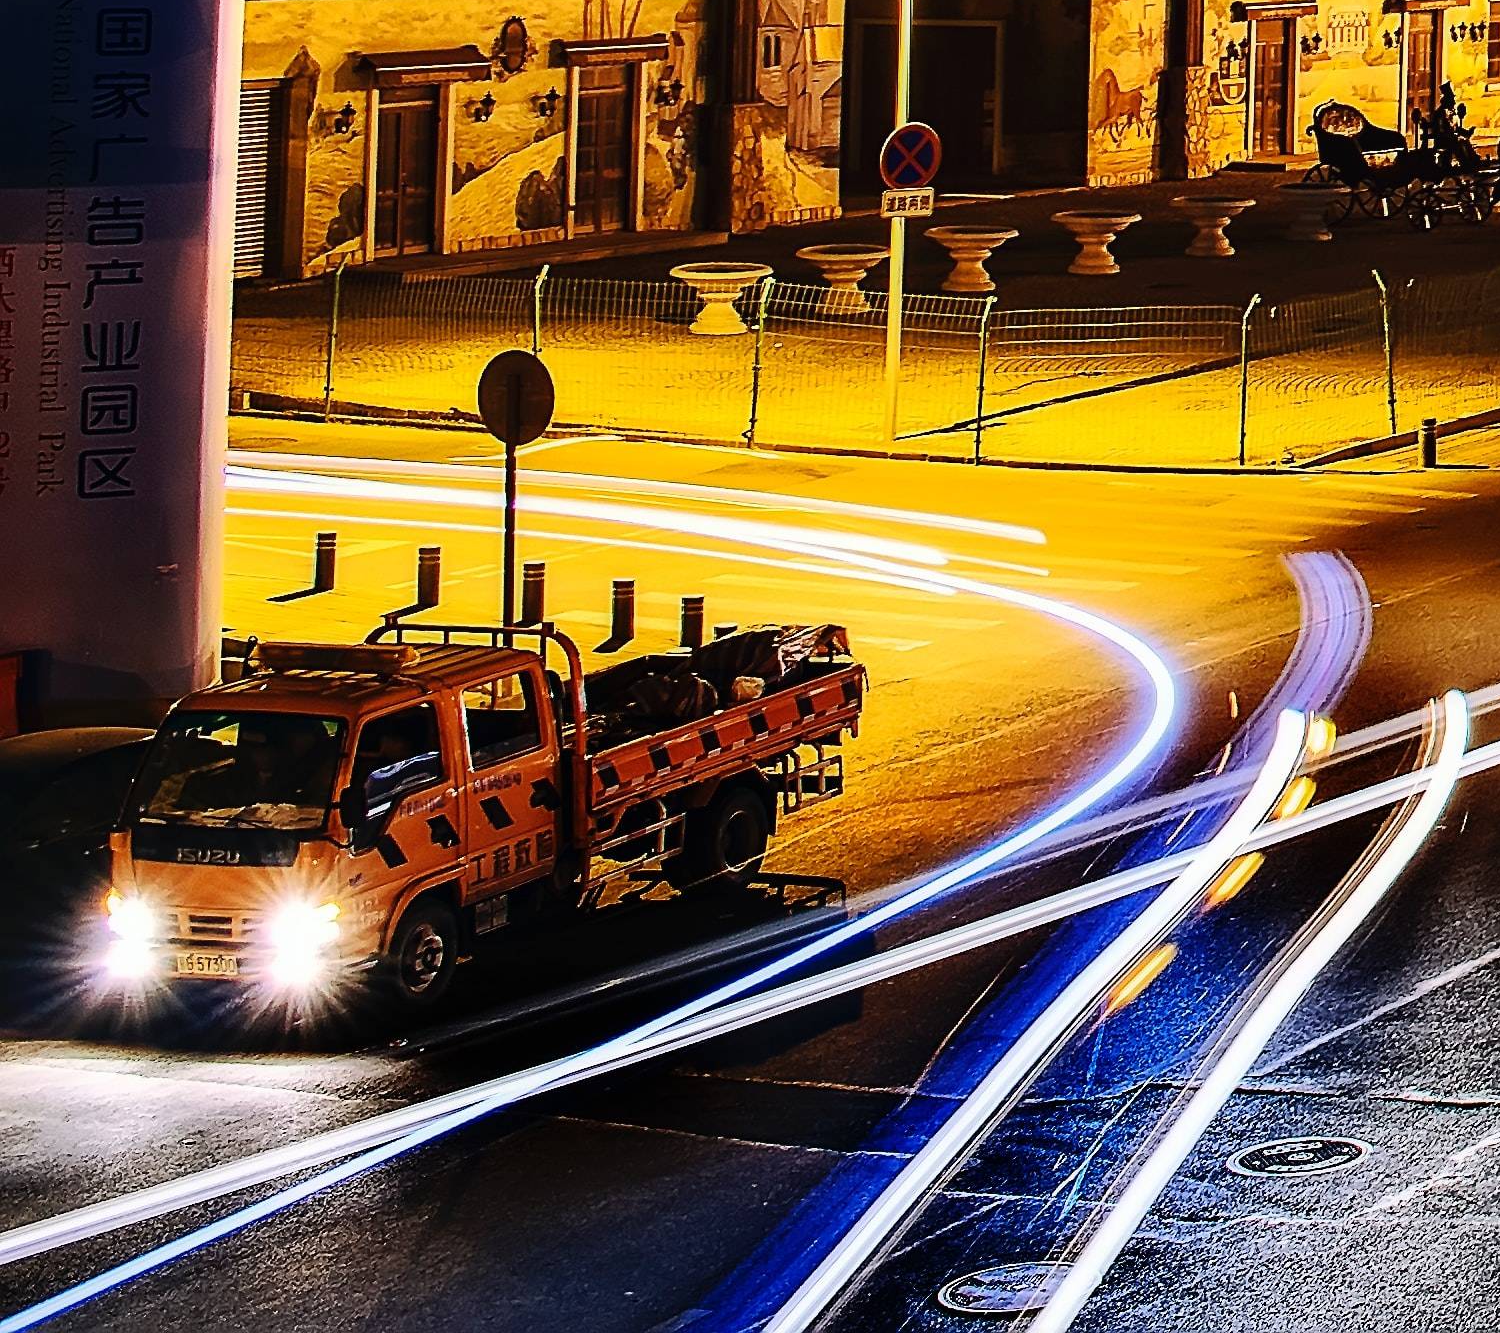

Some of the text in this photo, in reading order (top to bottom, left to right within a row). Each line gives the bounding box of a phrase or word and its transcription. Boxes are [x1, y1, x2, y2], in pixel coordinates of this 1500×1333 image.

[38, 116, 77, 273] Advertising
[38, 281, 71, 414] Industrial
[35, 433, 66, 498] Park
[176, 847, 241, 864] ISUZU
